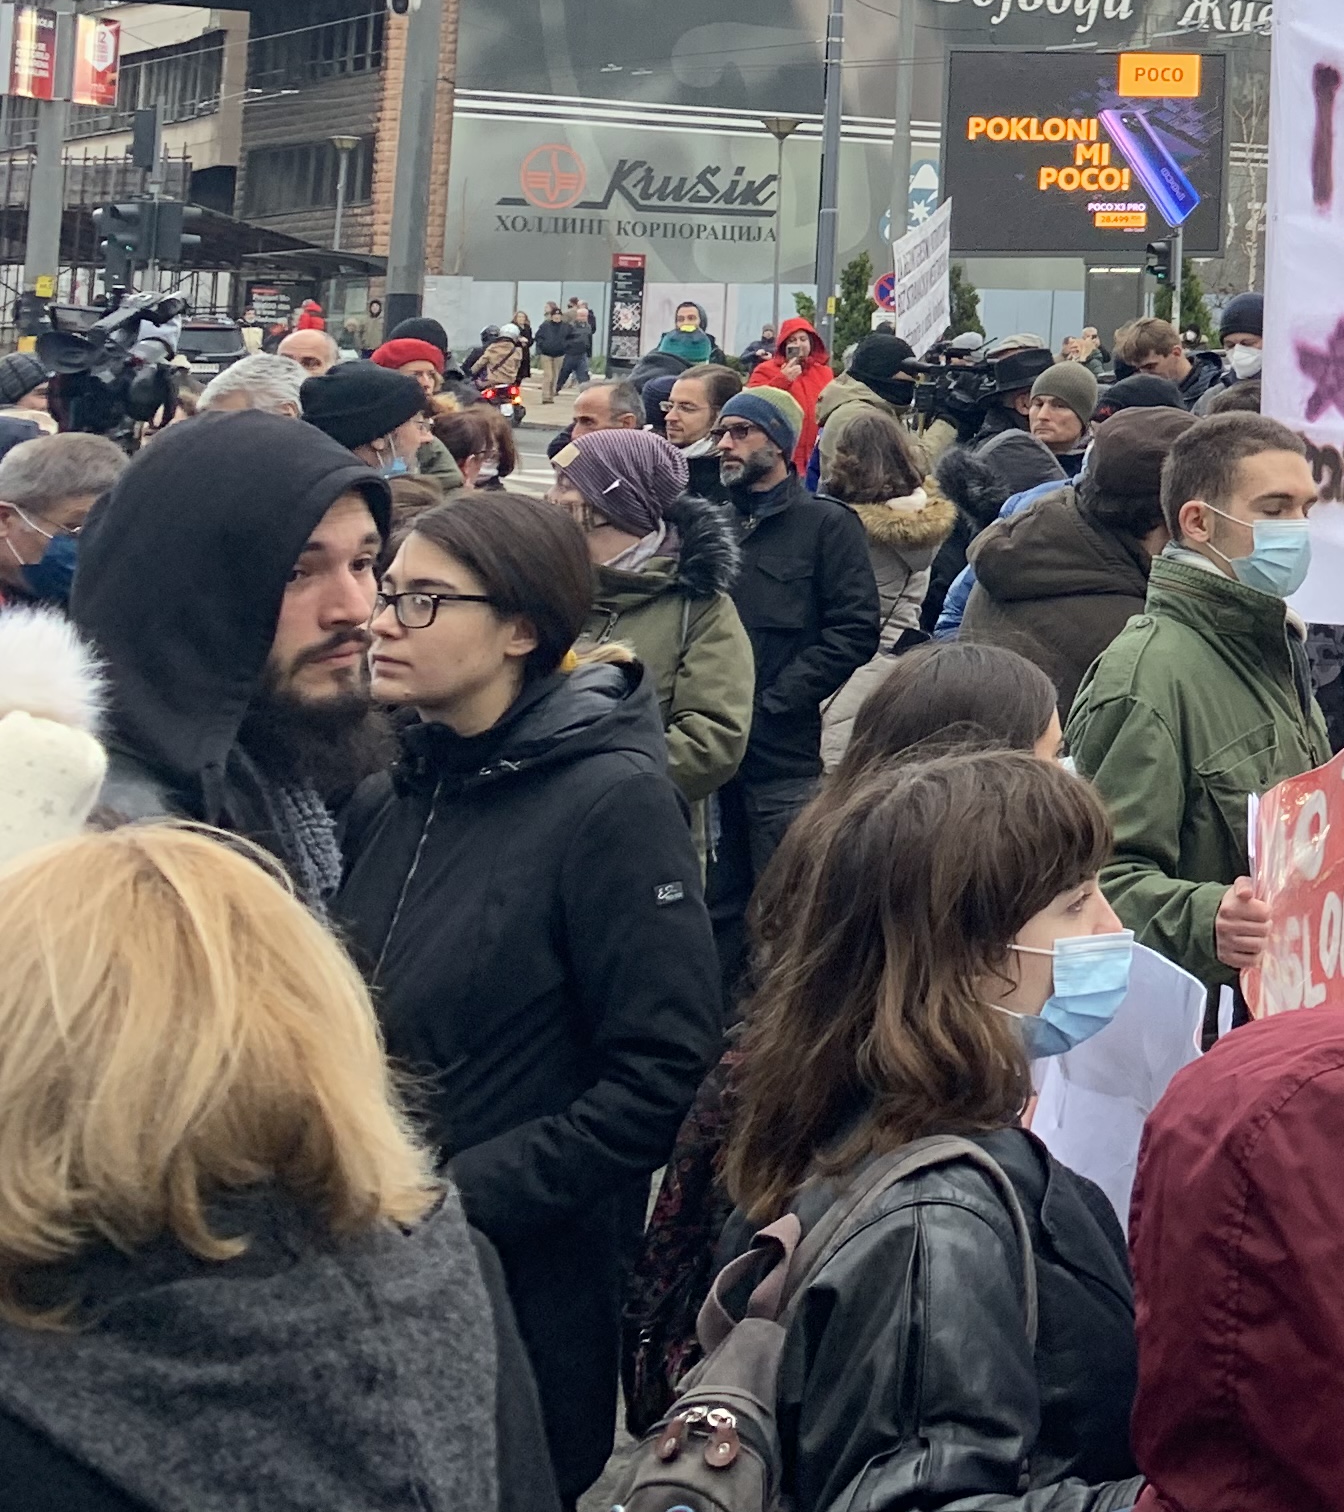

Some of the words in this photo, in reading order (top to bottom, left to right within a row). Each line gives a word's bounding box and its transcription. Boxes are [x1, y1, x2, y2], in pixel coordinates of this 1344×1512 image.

[1134, 67, 1184, 82] POCO
[967, 116, 1099, 141] POKLONI
[1074, 142, 1111, 167] MI
[1038, 166, 1132, 191] POCO!
[1087, 202, 1114, 212] POCO
[1126, 202, 1146, 212] PRO
[493, 214, 611, 236] ХОЛДИНГ
[616, 219, 778, 244] КОРПОРАЦИЈА
